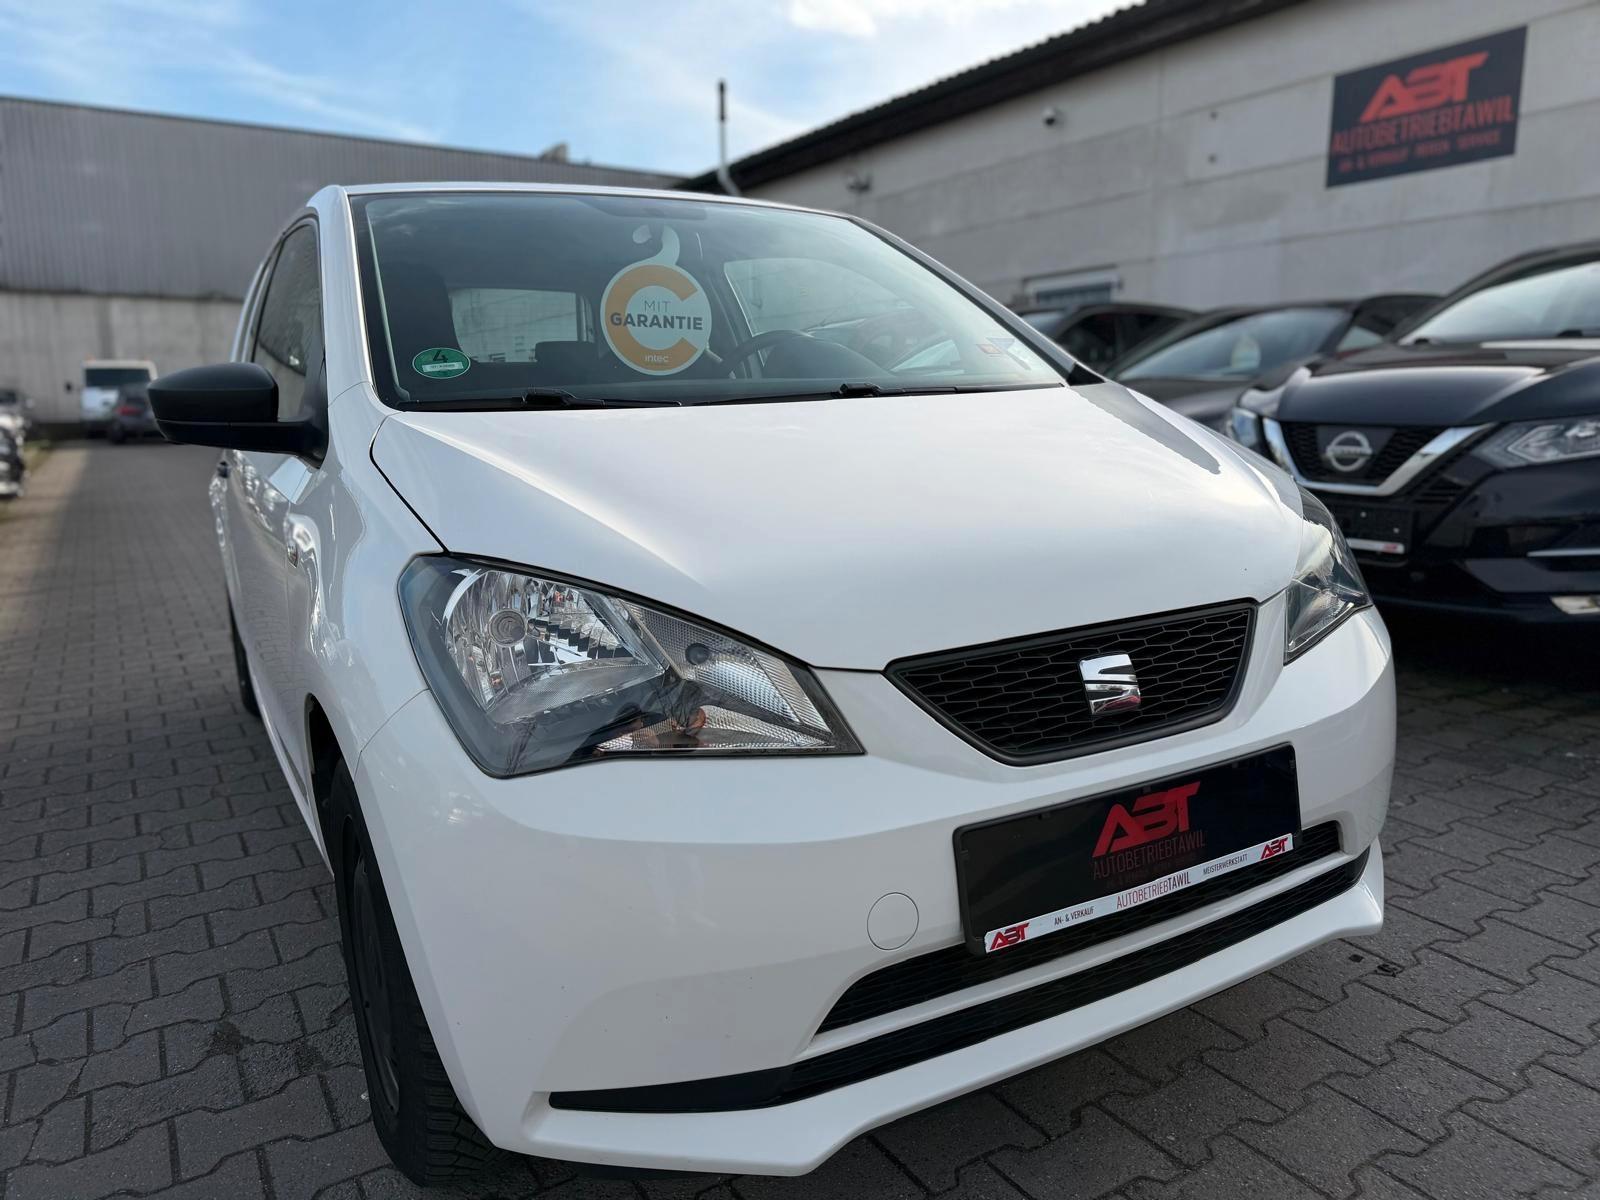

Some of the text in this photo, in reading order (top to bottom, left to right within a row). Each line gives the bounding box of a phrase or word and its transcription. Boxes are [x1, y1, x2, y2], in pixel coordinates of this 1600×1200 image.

[1360, 52, 1489, 123] ABT
[610, 312, 704, 331] GARANTIE
[644, 300, 671, 314] MIT
[645, 353, 669, 363] intec
[1092, 781, 1201, 858] ABT
[1093, 830, 1206, 880] AUTOBETRIEBTAWIL
[990, 922, 1030, 951] ABT
[1070, 906, 1095, 921] VERKAUF
[1116, 872, 1192, 910] AUTOBETRIEBTAWIL
[1203, 854, 1248, 875] MEISTERWERKSTATT
[1260, 837, 1289, 860] ABT
